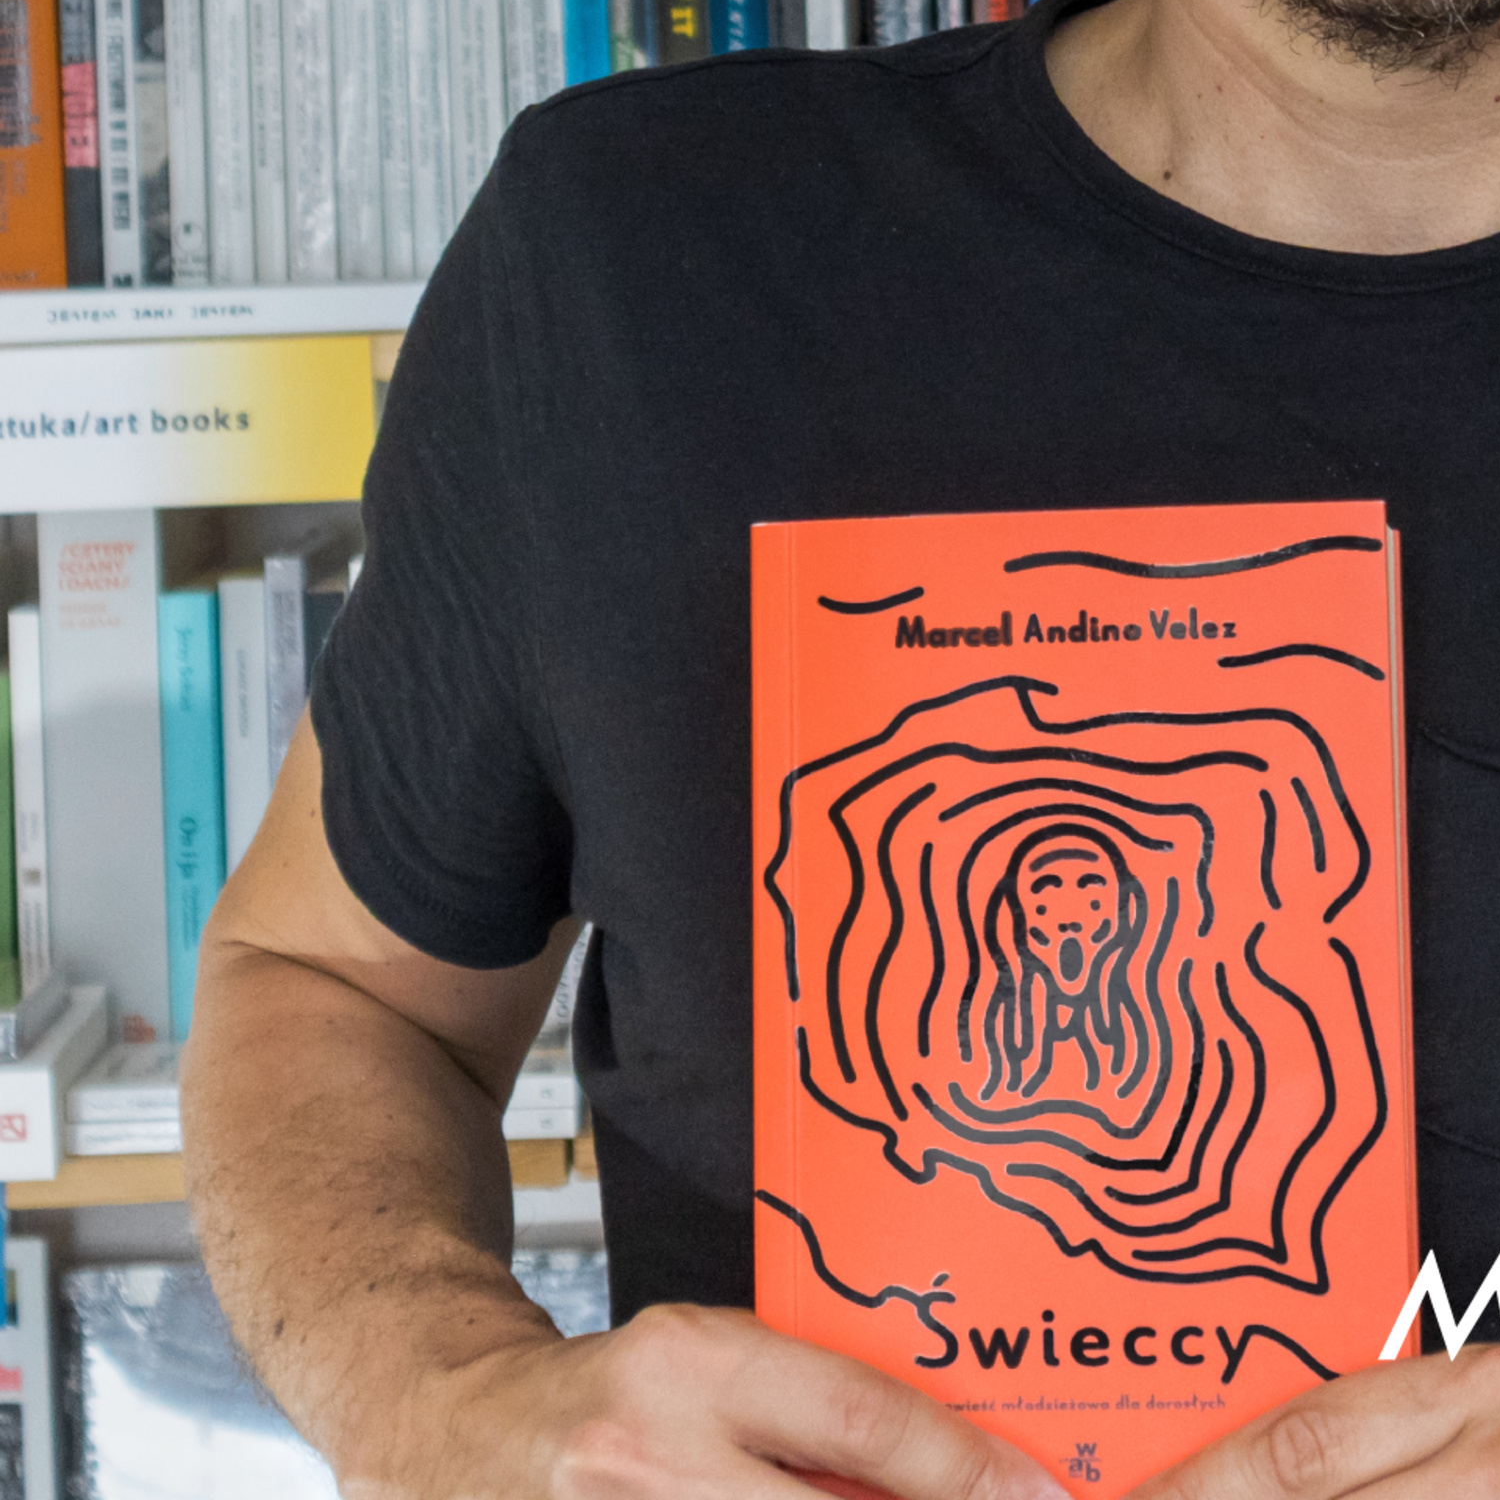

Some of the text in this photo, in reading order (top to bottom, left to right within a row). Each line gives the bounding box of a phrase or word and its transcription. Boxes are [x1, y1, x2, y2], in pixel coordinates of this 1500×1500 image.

[670, 6, 695, 39] IT
[132, 307, 175, 321] JAKI
[151, 407, 250, 434] books
[895, 606, 1238, 650] Marcel Andino Velez
[915, 1272, 1254, 1386] Świeccy
[1002, 1395, 1111, 1413] młodzieżowa
[1115, 1394, 1141, 1411] dla
[1146, 1393, 1227, 1414] dorosłych
